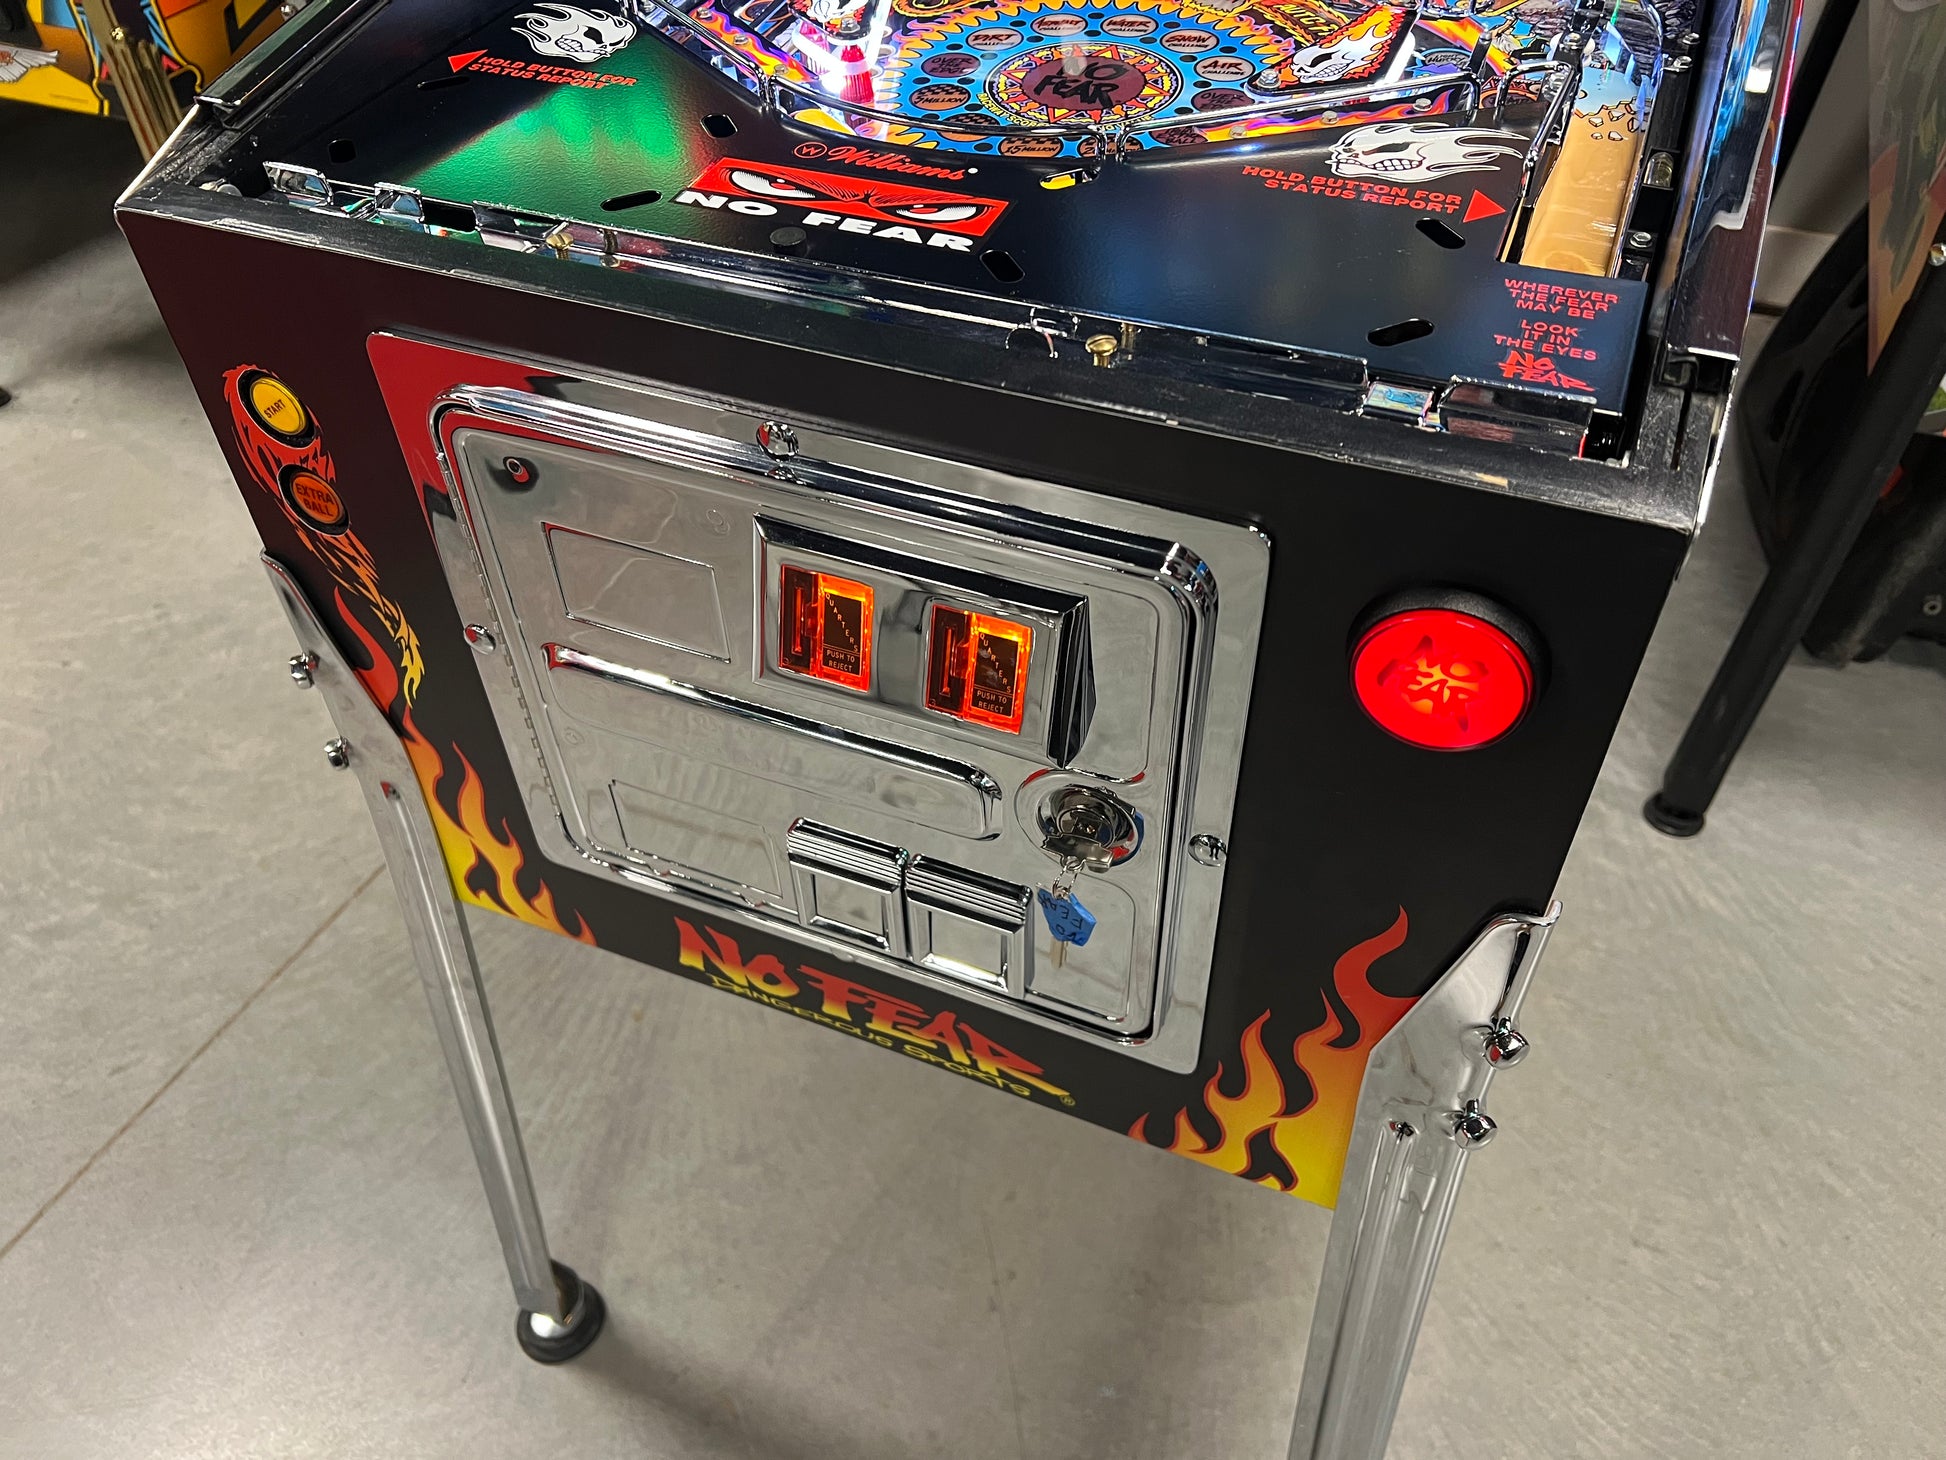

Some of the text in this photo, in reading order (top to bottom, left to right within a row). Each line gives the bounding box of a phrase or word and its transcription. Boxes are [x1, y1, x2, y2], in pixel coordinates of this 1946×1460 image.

[1106, 18, 1151, 28] WATER
[972, 33, 1019, 42] DIRT
[1165, 34, 1214, 43] SNOW
[478, 56, 639, 86] HOLD BUTTON FOR
[1202, 60, 1244, 71] AIR
[468, 63, 609, 90] STATUS REPORT
[1034, 75, 1120, 109] FEAR
[1200, 92, 1244, 101] OVER
[827, 146, 965, 180] Williams
[1242, 165, 1463, 205] HOLD BUTTON FOR
[1264, 179, 1460, 214] STATUS REPORT
[674, 190, 976, 252] NO FEAR
[1504, 278, 1619, 304] WHEREVER
[1509, 288, 1609, 312] THE FEAR
[1516, 299, 1596, 320] MAY BE
[1521, 319, 1579, 337] LOOK
[1524, 330, 1571, 346] IT IN
[1493, 334, 1597, 360] THE EYES
[1505, 350, 1555, 371] NO
[1498, 362, 1596, 392] FEAR
[264, 398, 287, 419] START
[295, 483, 334, 505] EXTRA
[303, 497, 334, 517] BALL
[825, 593, 859, 652] QUARTERS
[826, 649, 856, 663] PUSH TO
[828, 659, 853, 672] REJECT
[980, 633, 1012, 693] QUARTERS
[976, 690, 1008, 704] PUSH TO
[978, 700, 1004, 714] REJECT
[674, 916, 1071, 1096] NO FEAR
